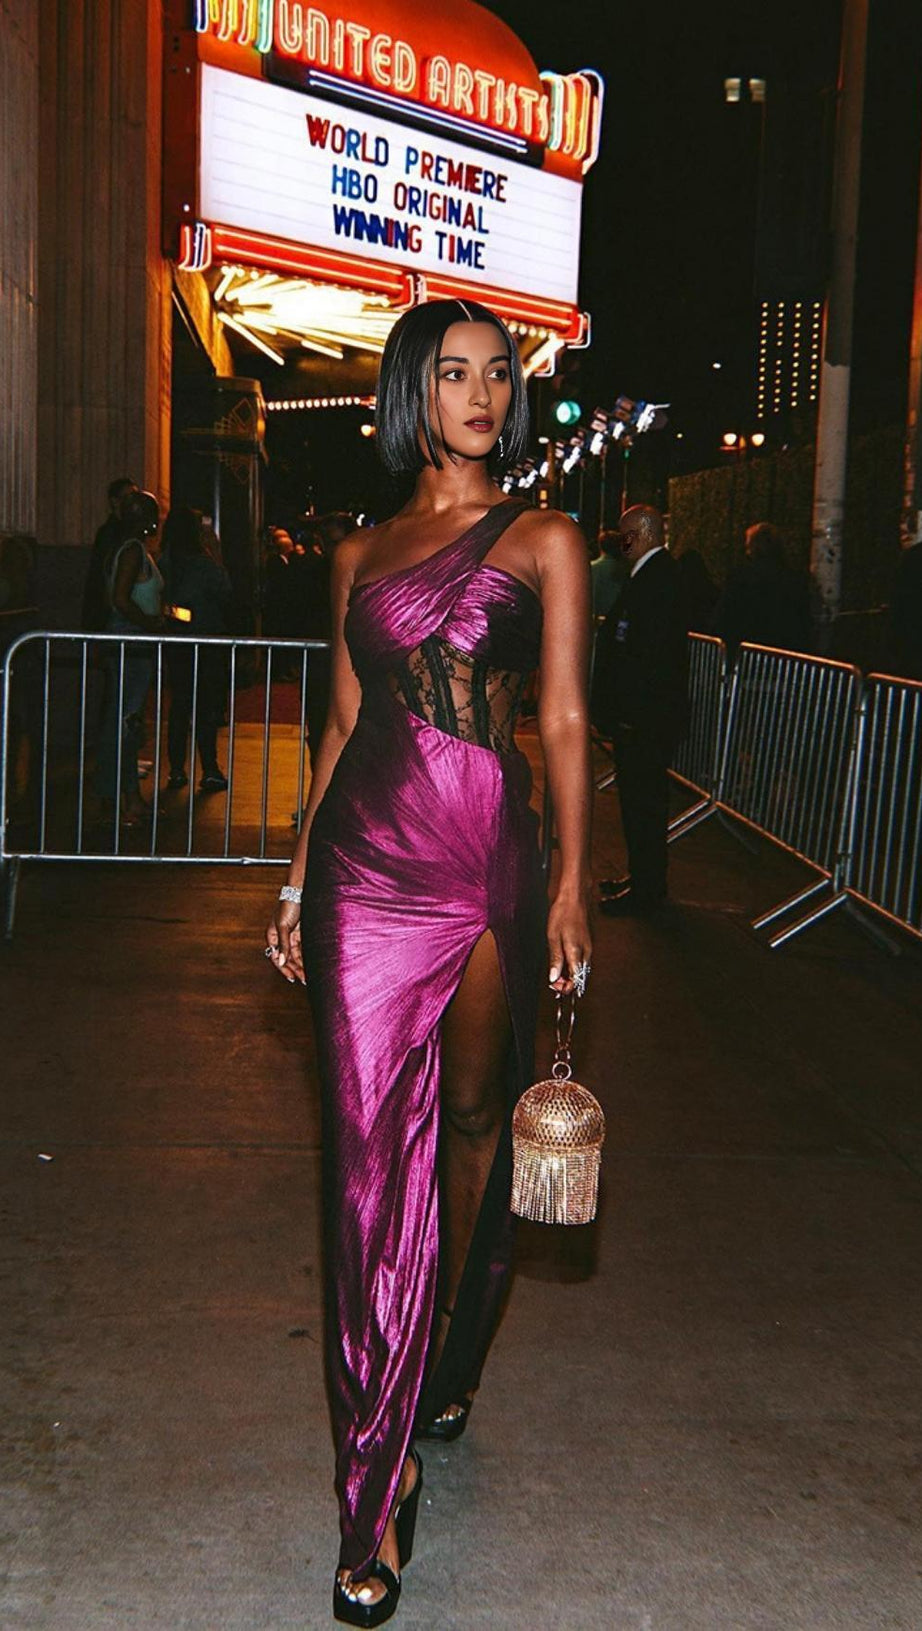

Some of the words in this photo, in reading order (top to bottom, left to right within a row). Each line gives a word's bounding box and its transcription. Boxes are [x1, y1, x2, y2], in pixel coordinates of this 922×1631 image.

[278, 0, 417, 93] UNITED
[428, 55, 549, 141] ARTISTS
[306, 113, 389, 167] WORLD
[405, 145, 508, 203] PREMIERE
[332, 164, 378, 203] HBO
[393, 182, 489, 234] ORIGINAL
[333, 203, 423, 253] WINNING
[435, 230, 486, 270] TIME
